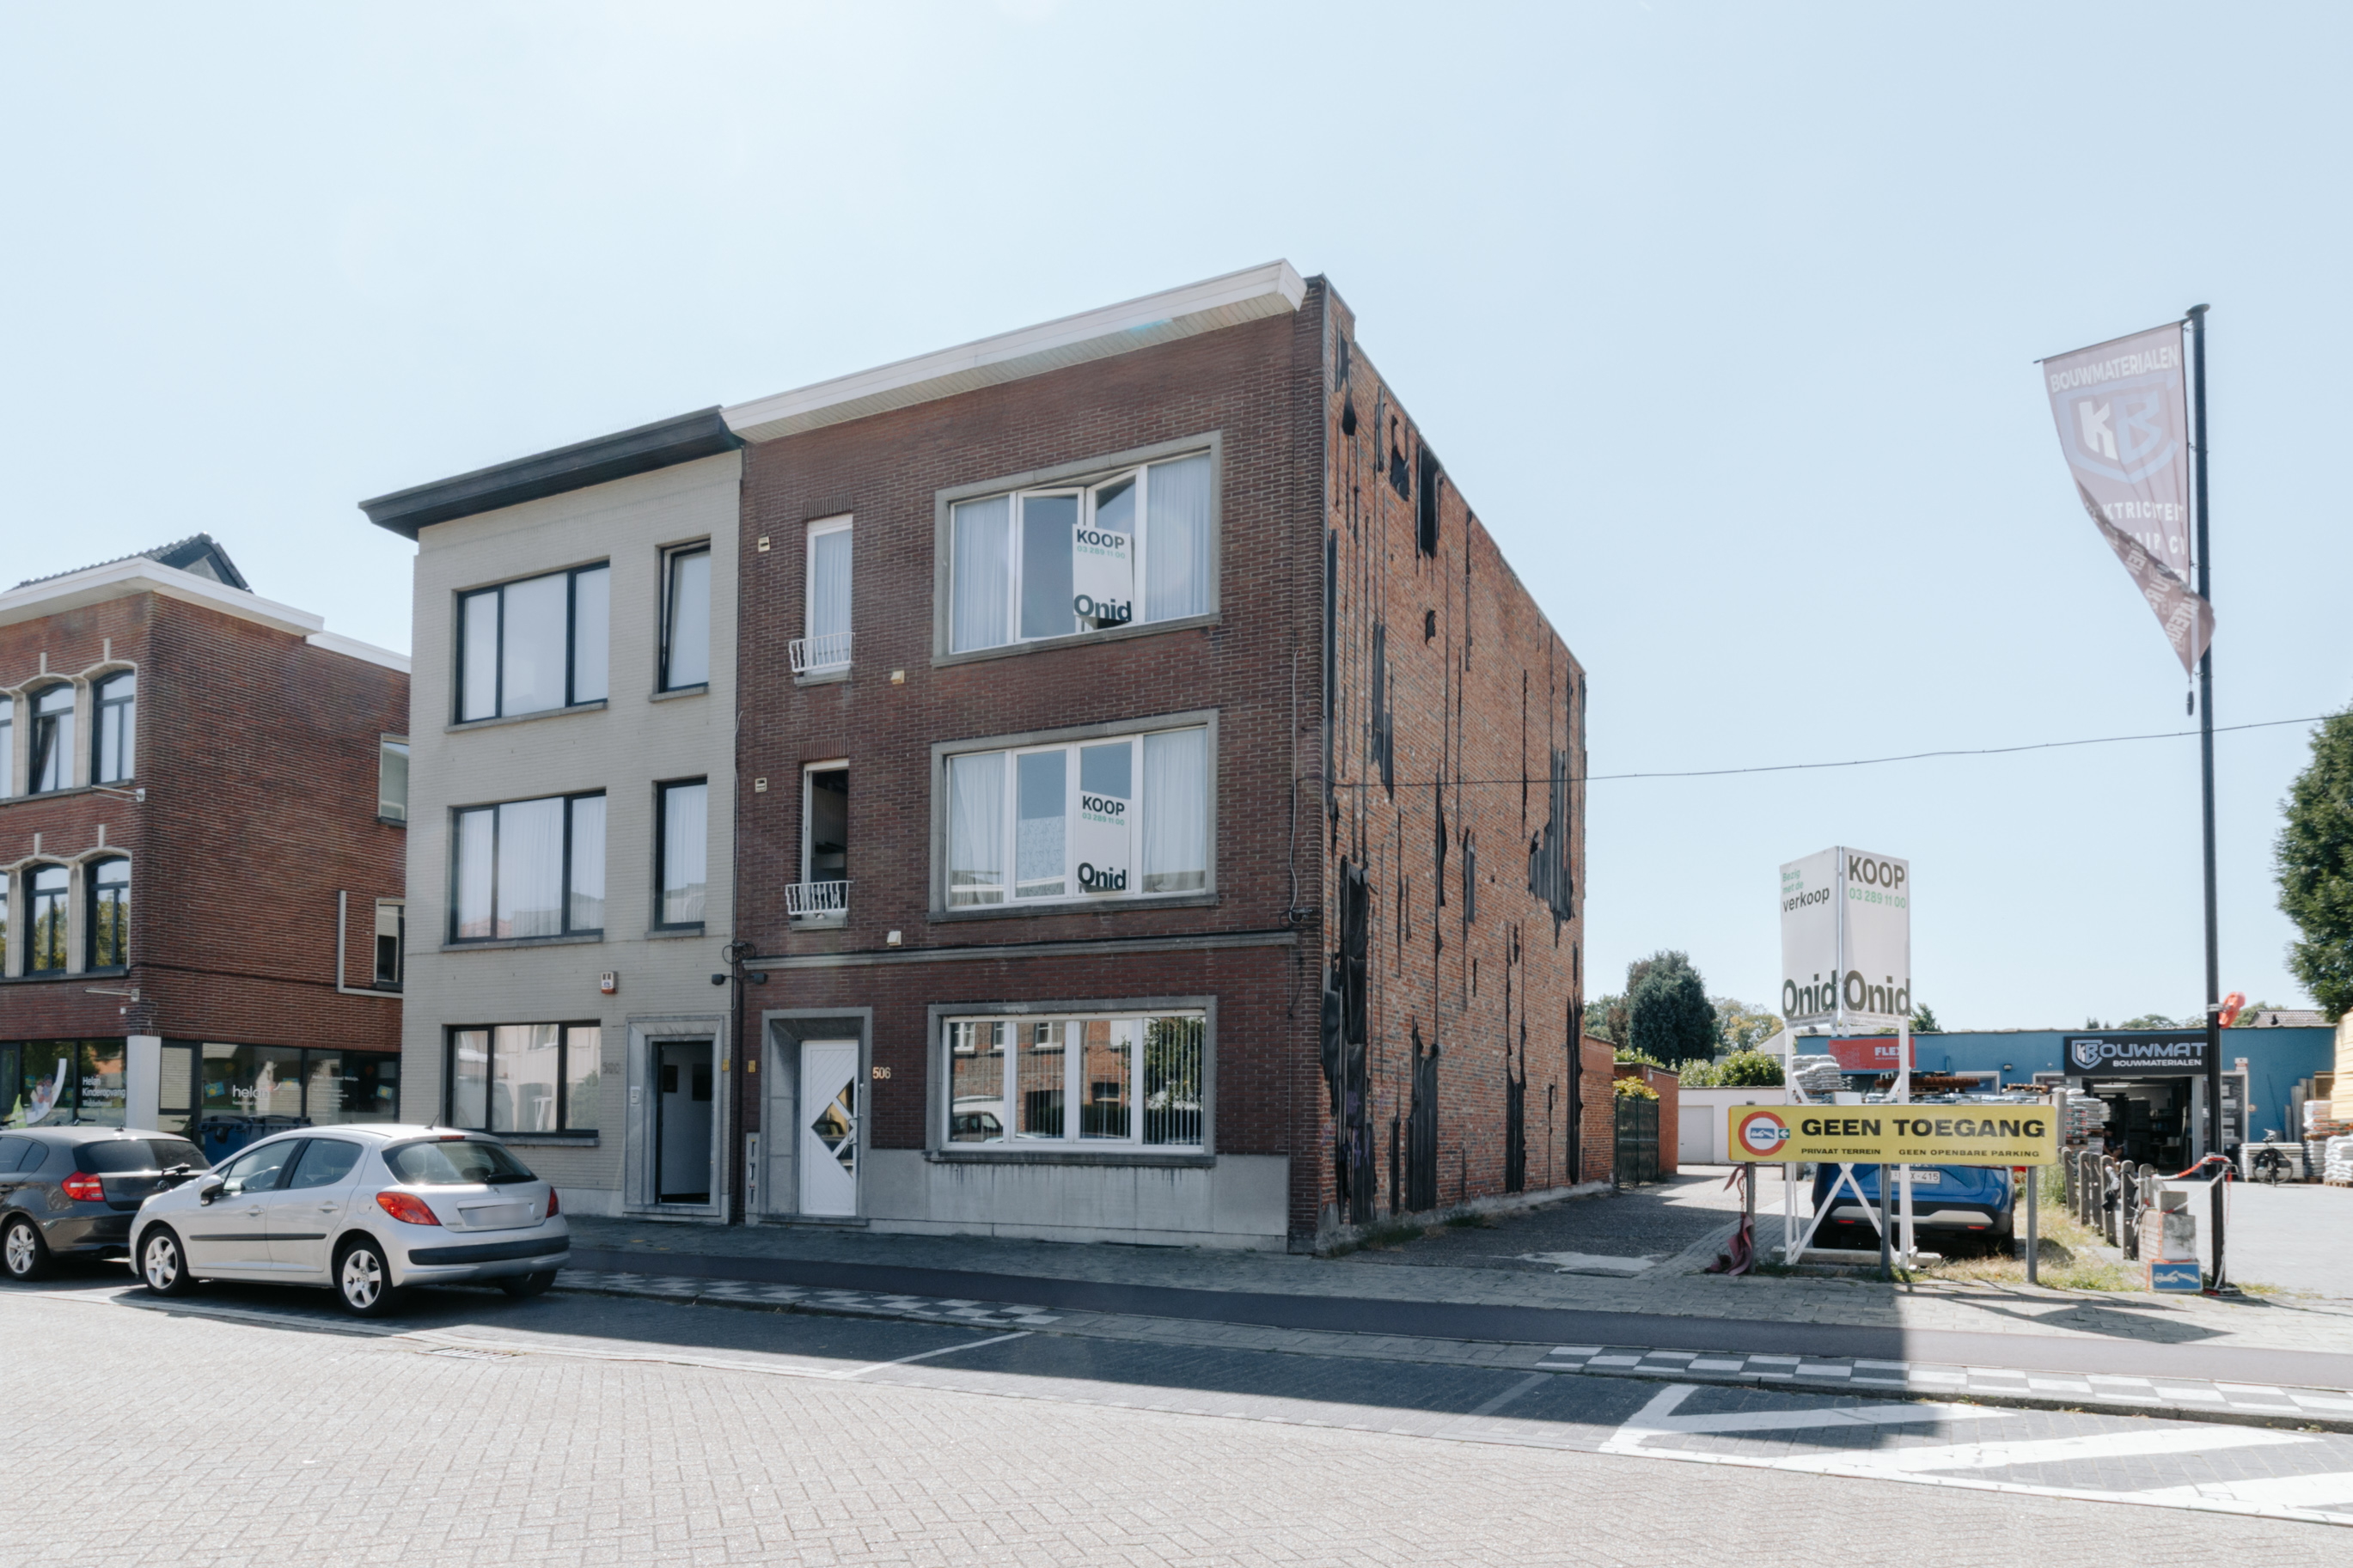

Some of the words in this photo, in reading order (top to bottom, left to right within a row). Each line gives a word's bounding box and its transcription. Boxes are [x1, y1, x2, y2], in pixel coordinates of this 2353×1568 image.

[2050, 345, 2179, 393] BOUWMATERIALEN
[1077, 528, 1125, 549] KOOP
[1077, 545, 1088, 553] 03
[1090, 547, 1105, 556] 289
[1074, 595, 1132, 621] Onid
[1082, 796, 1125, 815] KOOP
[1082, 812, 1091, 821] 03
[1093, 814, 1107, 822] 289
[1078, 862, 1126, 890] Onid
[1782, 869, 1800, 882] Bezig
[1849, 855, 1905, 889] KOOP
[1782, 883, 1794, 894] met
[1795, 881, 1804, 890] de
[1783, 888, 1830, 912] verkoop
[1849, 888, 1861, 900] 03
[1865, 890, 1882, 904] 289
[1885, 895, 1892, 906] 11
[1894, 896, 1906, 909] 00
[1782, 970, 1837, 1018] Onid
[1843, 970, 1910, 1016] Onid
[83, 1077, 101, 1085] Helan
[872, 1066, 891, 1079] 506
[83, 1088, 125, 1098] Kinderopvang
[232, 1084, 270, 1098] helan
[1801, 1119, 1881, 1136] GEEN
[1892, 1119, 2045, 1138] TOEGANG
